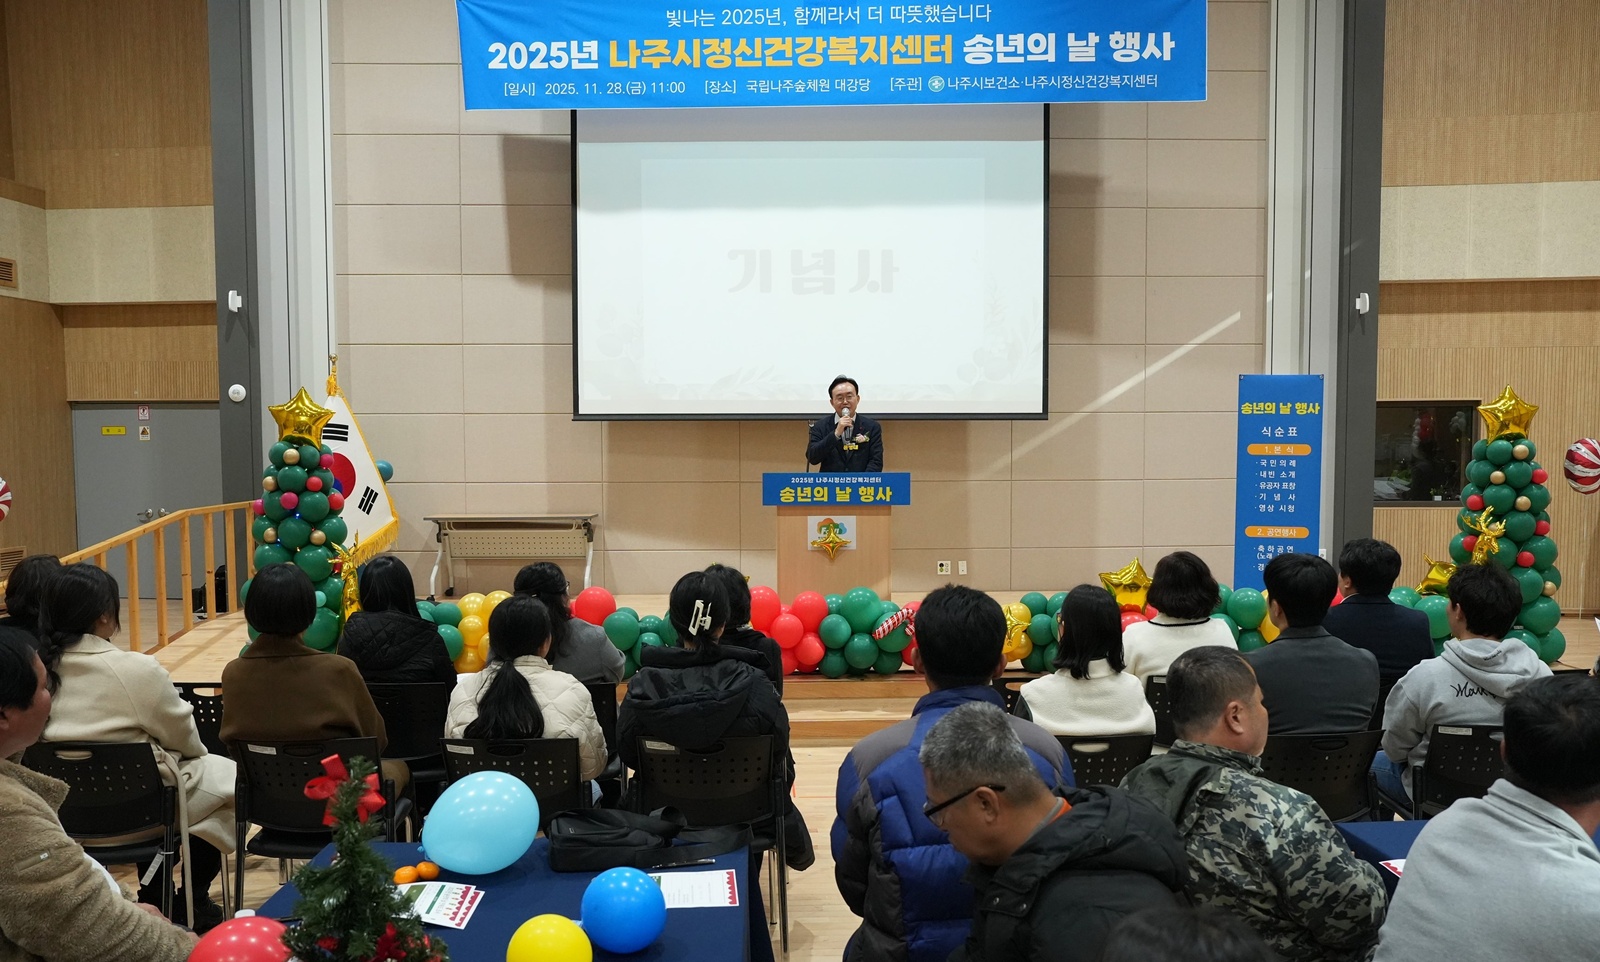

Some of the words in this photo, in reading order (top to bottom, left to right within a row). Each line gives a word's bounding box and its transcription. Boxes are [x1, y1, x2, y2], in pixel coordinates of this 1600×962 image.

[666, 9, 716, 28] 빛나는
[721, 8, 788, 27] 2025년,
[794, 6, 861, 25] 함께라서
[868, 6, 883, 24] 더
[890, 4, 992, 24] 따뜻했습니다
[488, 41, 599, 70] 2025년
[609, 35, 953, 68] 나주시정신건강복지센터
[963, 34, 1056, 65] 송년의
[1067, 33, 1099, 62] 날
[1109, 31, 1176, 61] 행사
[504, 83, 536, 96] [일시]
[545, 83, 580, 96] 2025.
[583, 83, 602, 95] 11.
[606, 81, 646, 95] 28.(금)
[651, 81, 686, 94] 11:00
[704, 80, 737, 94] [장소]
[746, 79, 830, 94] 국립나주숲체원
[835, 78, 871, 92] 대강당
[890, 77, 922, 92] [주관]
[948, 75, 1158, 90] 나주시보건소·나주시정신건강복지센터
[727, 249, 900, 295] 기념사
[1241, 402, 1276, 415] 송년의
[1280, 402, 1292, 415] 날
[1295, 402, 1320, 415] 행사
[1262, 426, 1298, 437] 식순표
[816, 476, 882, 484] 나주시정신건강복지센터
[1280, 471, 1296, 479] 소개
[1260, 482, 1280, 490] 유공자
[1282, 482, 1296, 490] 표창
[780, 486, 828, 503] 송년의
[836, 486, 852, 502] 날
[858, 486, 892, 502] 행사
[1259, 504, 1275, 513] 영상
[1279, 505, 1295, 513] 시청
[1257, 528, 1265, 537] 2.
[1267, 529, 1296, 538] 공연행사
